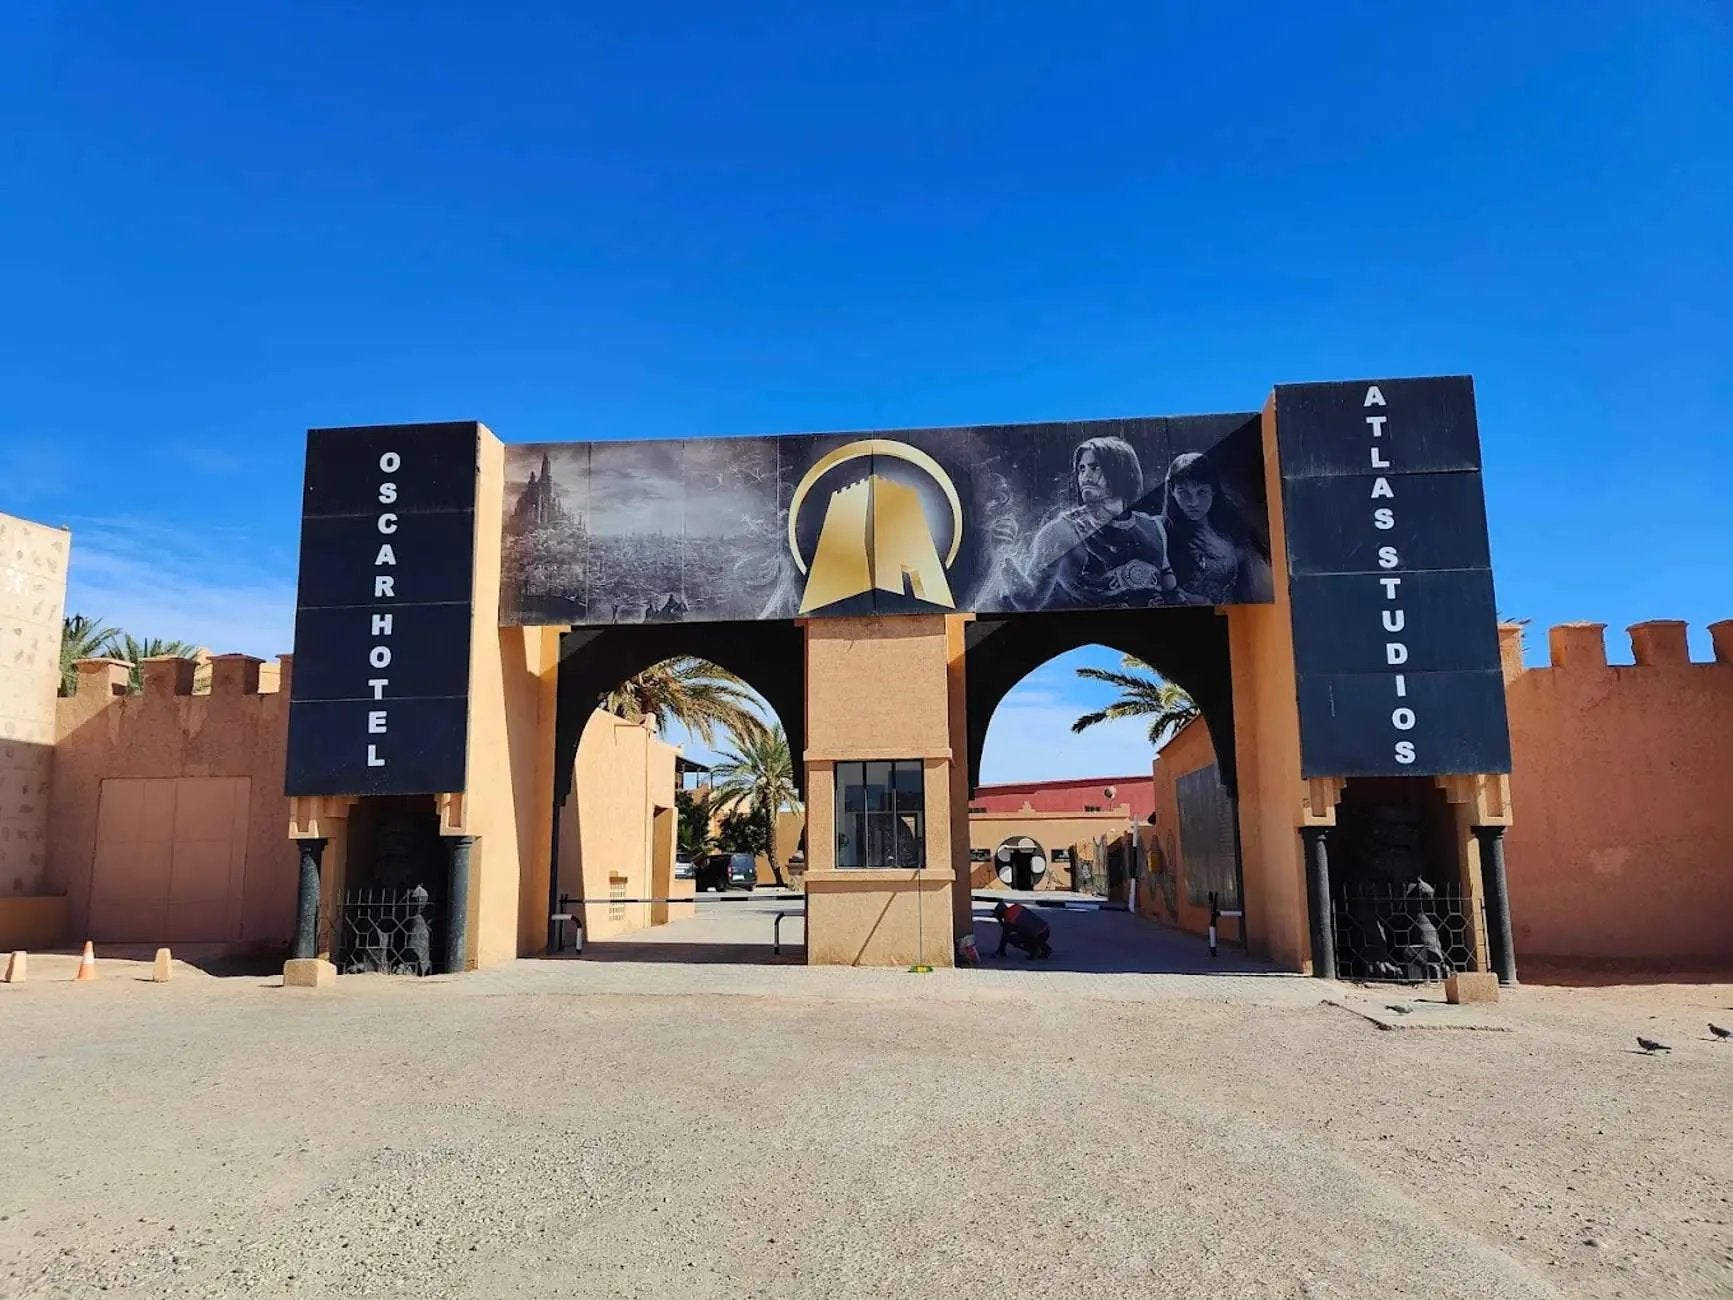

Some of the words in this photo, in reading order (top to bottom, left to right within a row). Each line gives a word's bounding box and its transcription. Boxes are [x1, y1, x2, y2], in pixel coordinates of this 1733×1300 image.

[374, 452, 401, 597] OSCAR
[1363, 385, 1395, 530] ATLAS
[367, 613, 392, 767] HOTEL
[1378, 546, 1416, 764] STUDIOS
